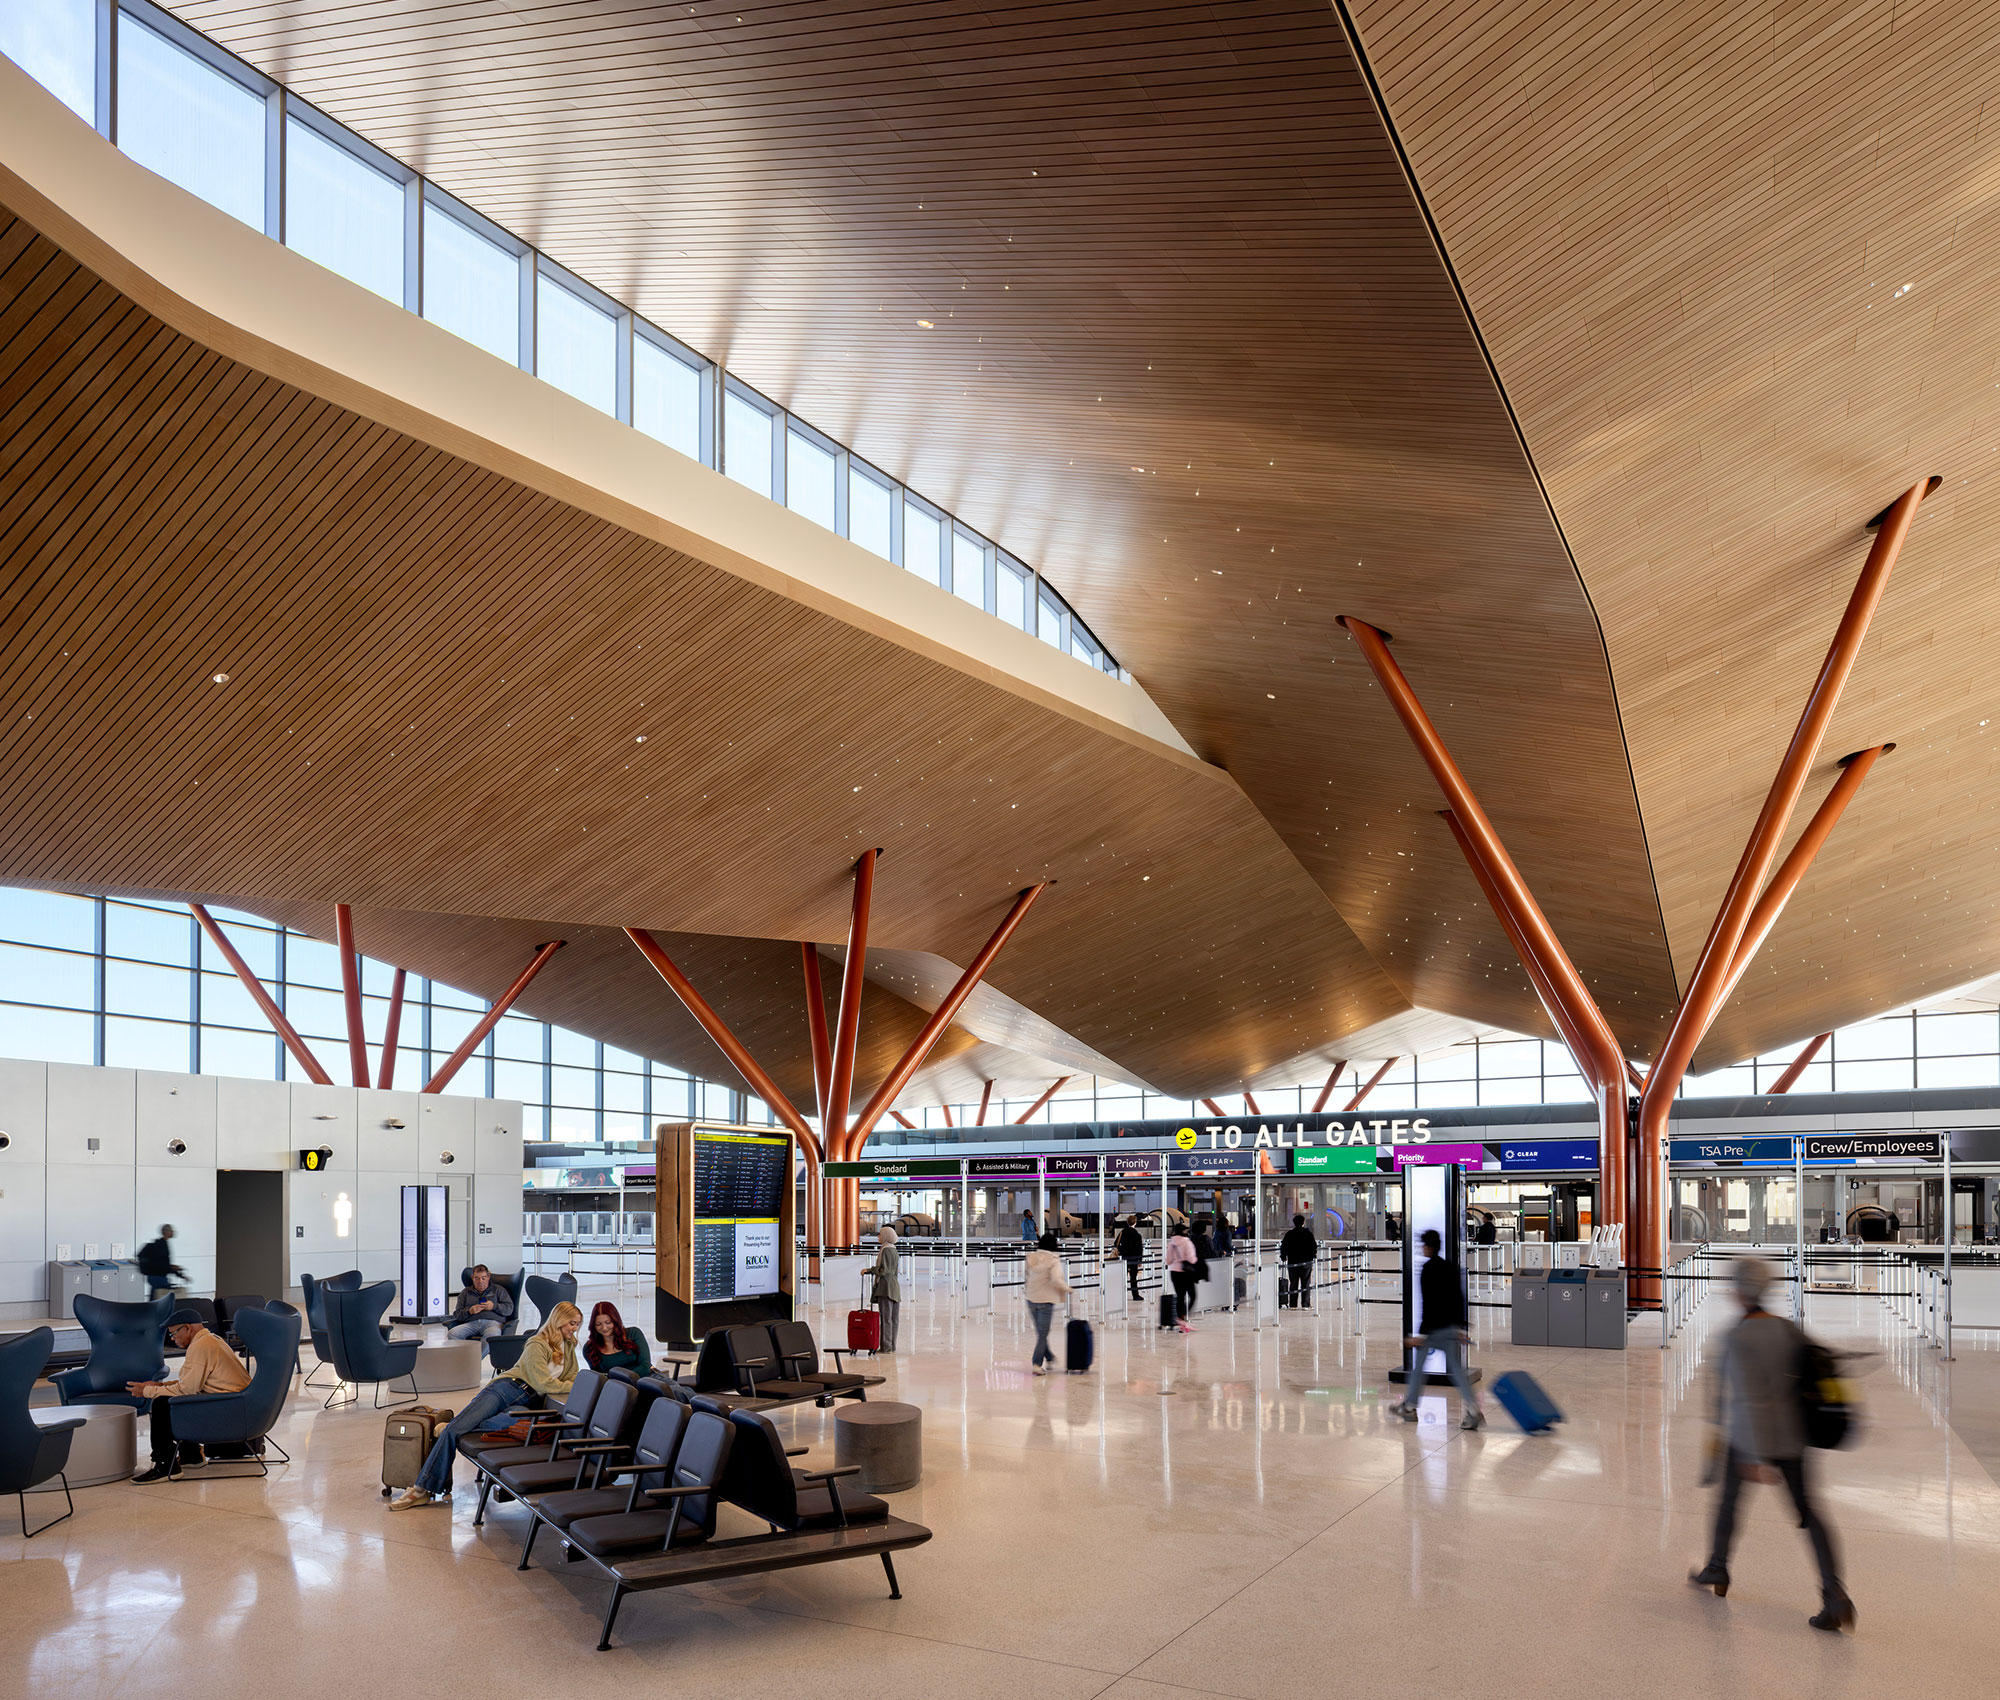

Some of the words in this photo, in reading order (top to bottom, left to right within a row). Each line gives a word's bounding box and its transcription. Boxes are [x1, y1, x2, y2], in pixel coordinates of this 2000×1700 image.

[1206, 1125, 1242, 1149] TO
[1254, 1123, 1313, 1148] ALL
[1326, 1118, 1431, 1146] GATES
[1699, 1146, 1721, 1156] TSA
[1724, 1145, 1744, 1156] Pre
[1810, 1140, 1934, 1155] Crew/Employees
[1297, 1156, 1328, 1164] Standard
[1397, 1153, 1425, 1163] Priority
[874, 1164, 907, 1174] Standard
[982, 1163, 1004, 1171] Assisted
[1010, 1162, 1031, 1171] Military
[1055, 1159, 1088, 1171] Priority
[1115, 1158, 1150, 1170] Priority
